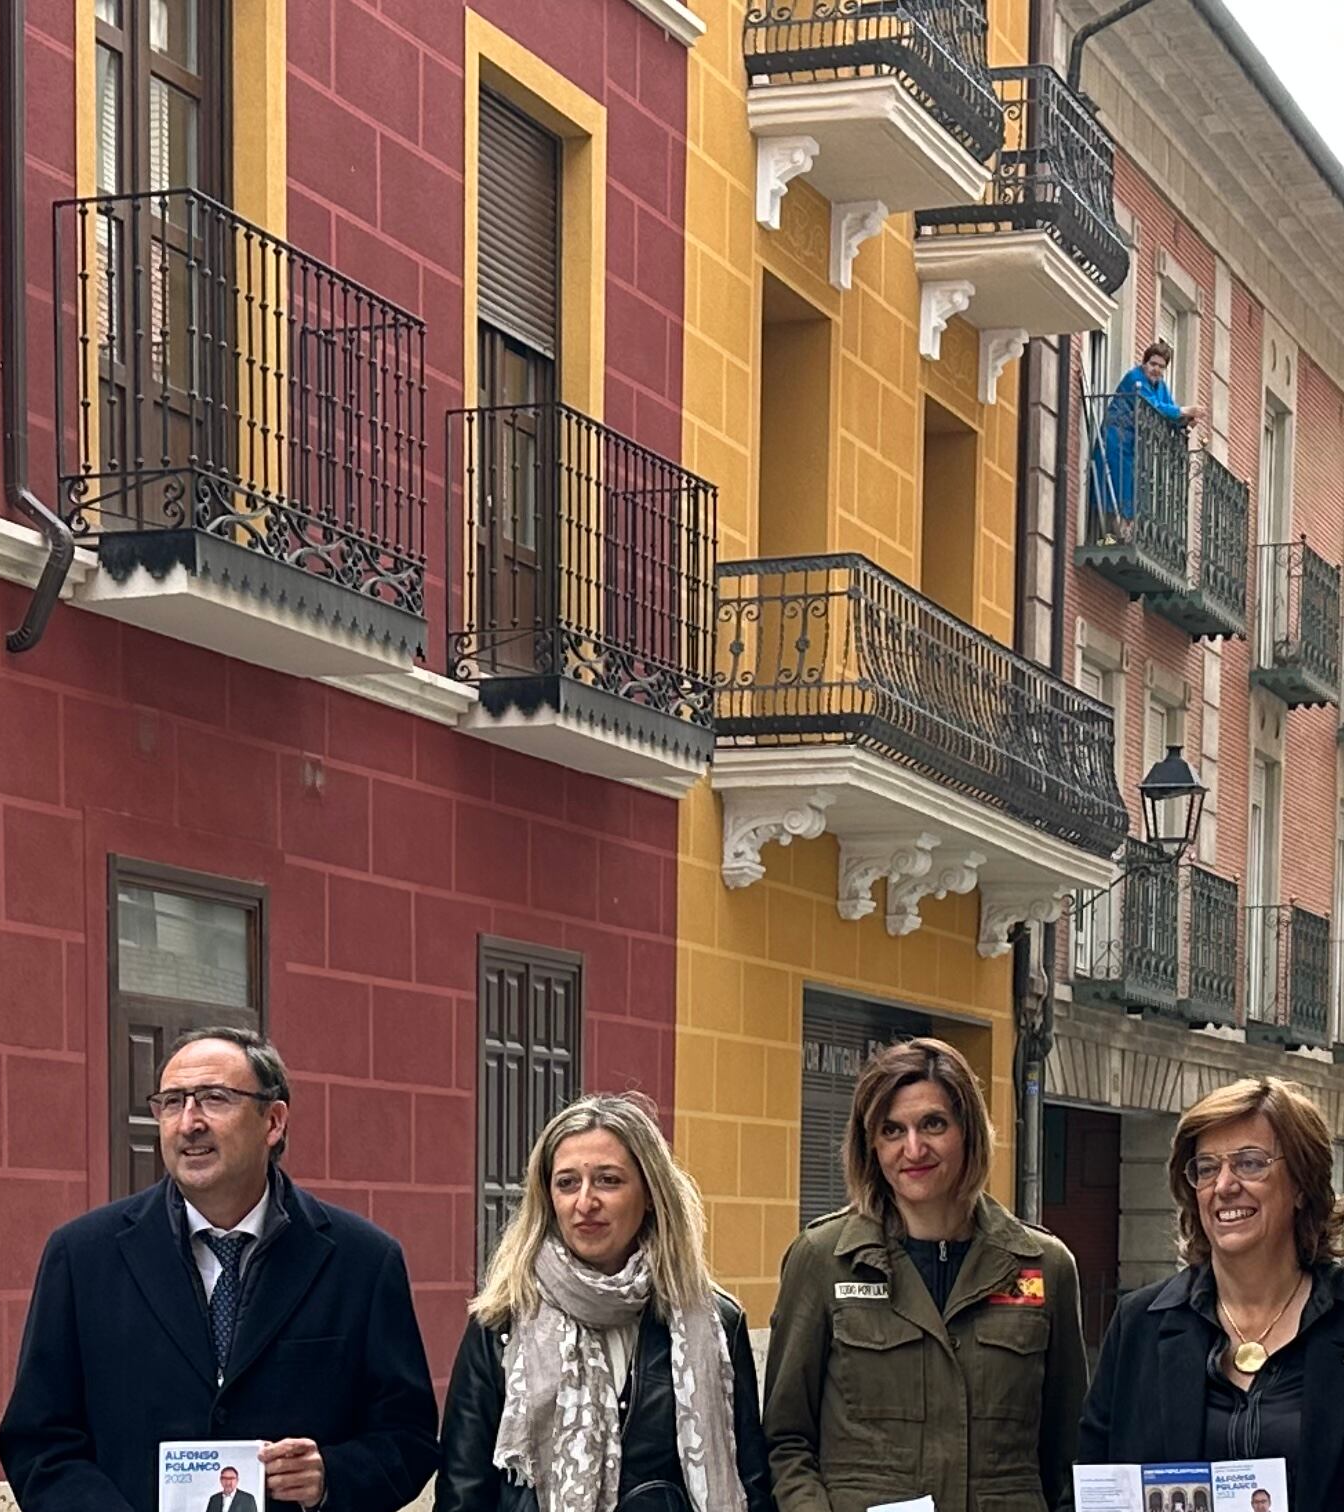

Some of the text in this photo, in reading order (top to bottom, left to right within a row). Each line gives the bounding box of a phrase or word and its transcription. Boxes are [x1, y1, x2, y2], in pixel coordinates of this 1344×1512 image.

[165, 1450, 219, 1460] ALFONSO
[165, 1462, 221, 1472] POLANCO
[1215, 1473, 1256, 1483] ALFONSO
[1216, 1482, 1258, 1491] POLANCO
